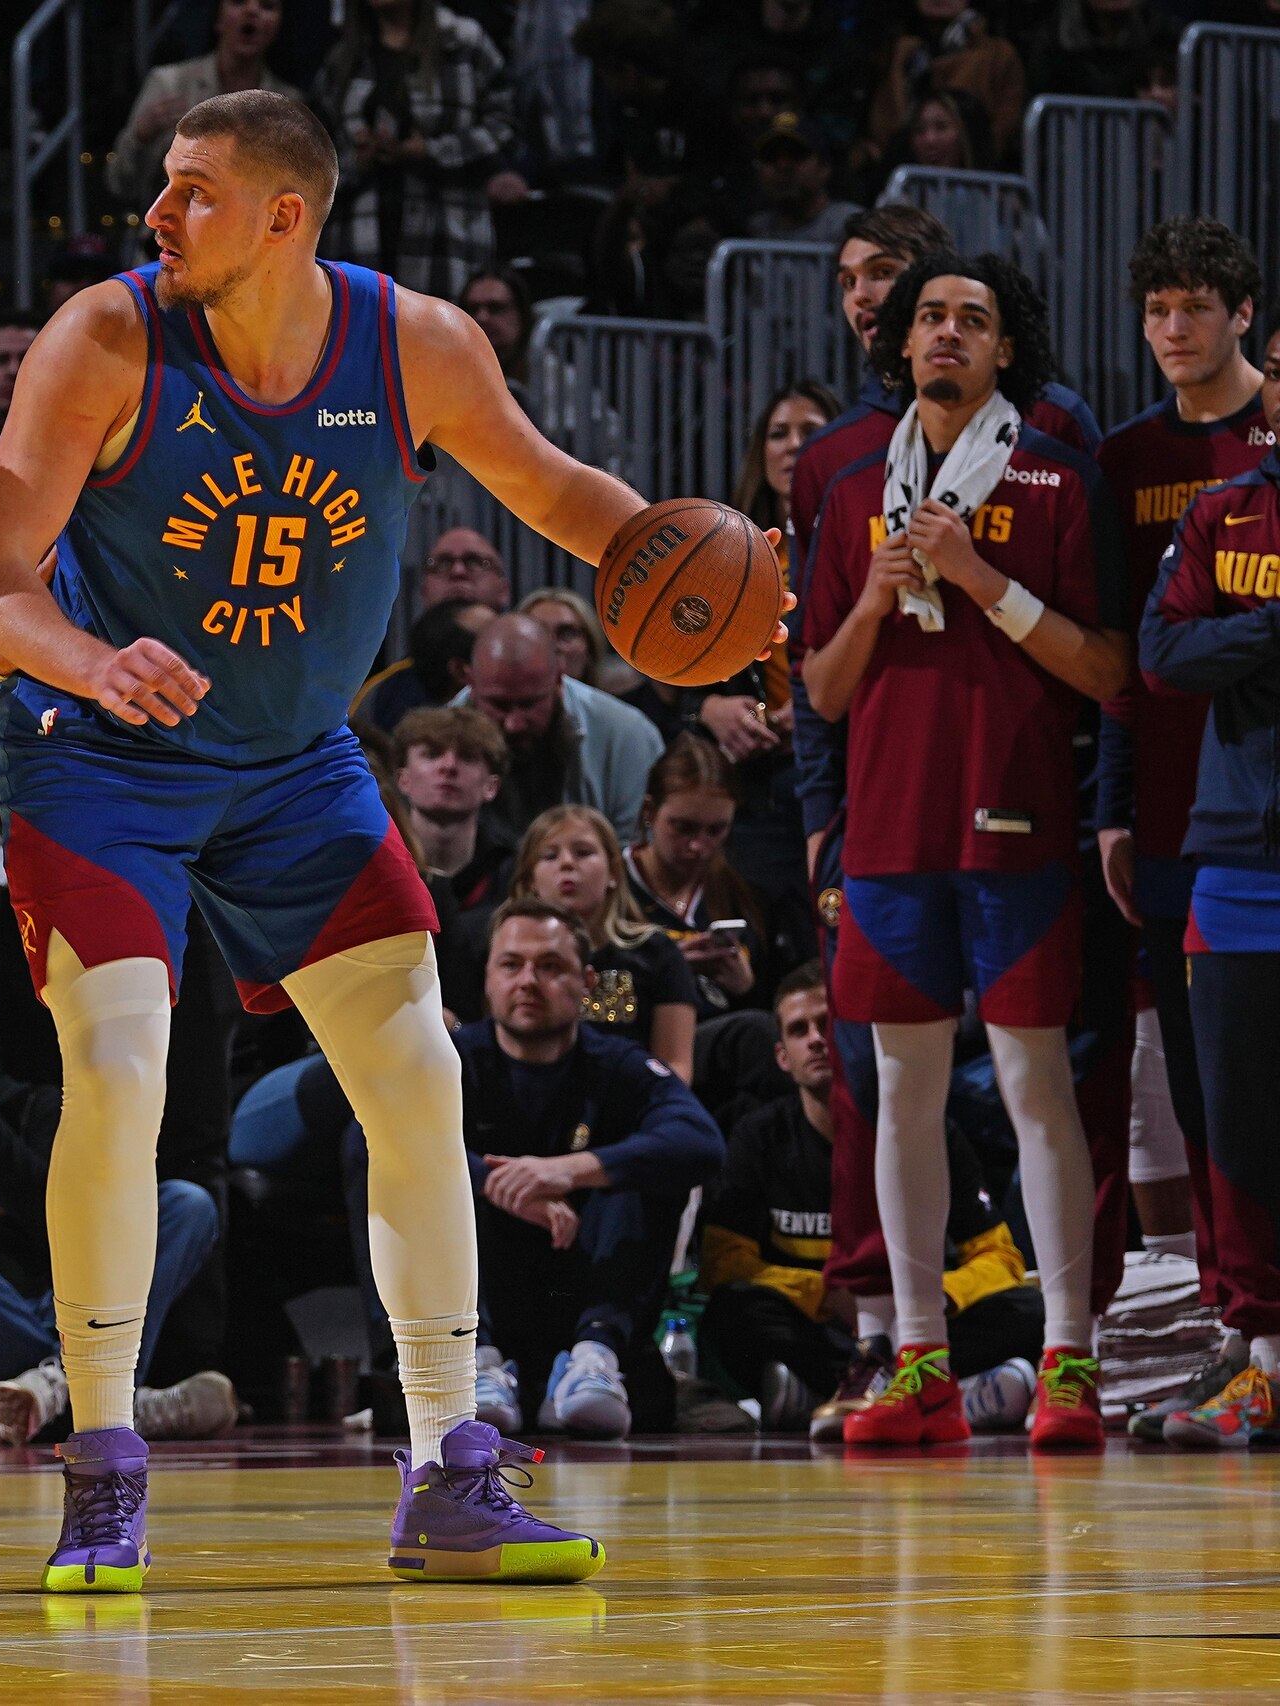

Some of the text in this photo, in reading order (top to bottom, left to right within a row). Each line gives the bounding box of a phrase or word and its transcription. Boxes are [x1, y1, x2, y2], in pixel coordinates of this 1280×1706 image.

[317, 408, 377, 427] ibotta
[161, 452, 366, 550] MILE HIGH
[1004, 464, 1061, 488] botta
[230, 513, 307, 587] 15
[1215, 550, 1280, 598] NUG
[605, 523, 692, 628] Wilson
[201, 594, 306, 646] CITY
[769, 1207, 832, 1236] ENVE
